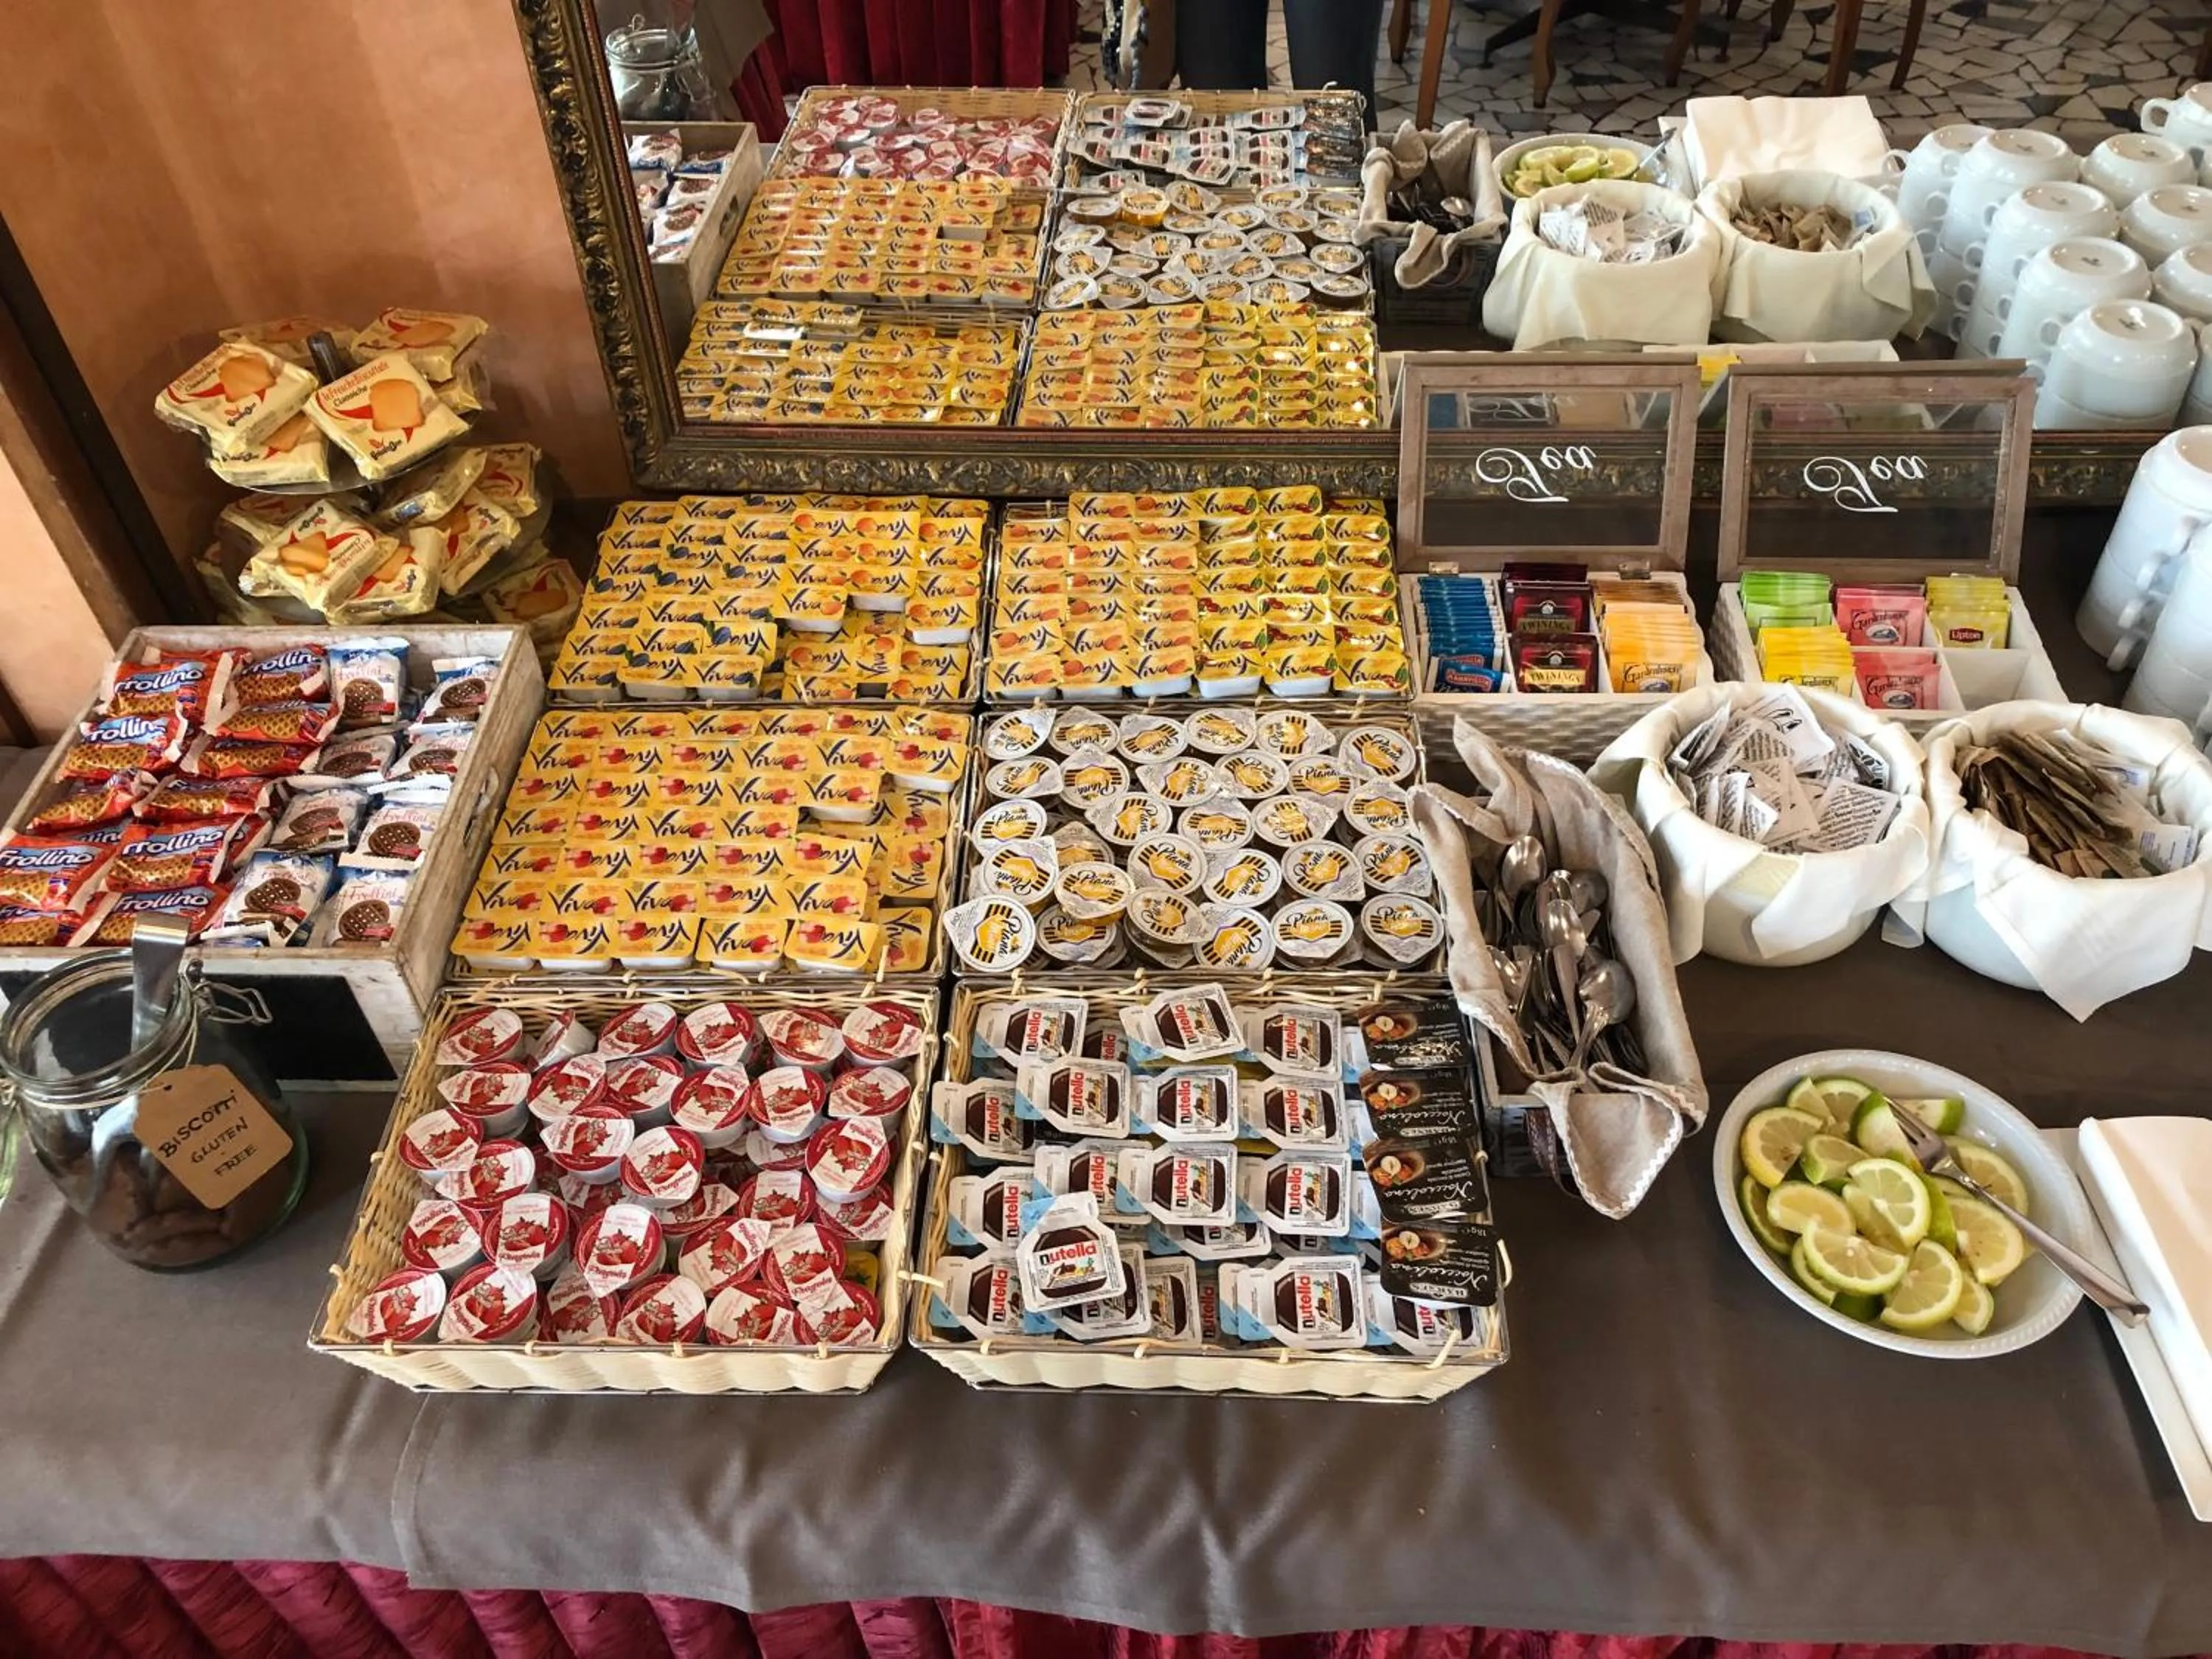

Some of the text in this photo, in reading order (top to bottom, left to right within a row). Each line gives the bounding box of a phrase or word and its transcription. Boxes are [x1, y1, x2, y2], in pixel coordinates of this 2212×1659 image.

[681, 501, 720, 516] Viva
[1155, 496, 1192, 516] Viva
[668, 524, 706, 543] Viva
[731, 520, 770, 540] Viva
[814, 518, 851, 537] Viva
[877, 518, 914, 540] Viva
[937, 524, 976, 545] Viva
[687, 549, 723, 569] Viva
[794, 539, 832, 558] Viva
[925, 546, 958, 566] Viva
[1006, 546, 1043, 568] Viva
[1090, 546, 1129, 567] Viva
[675, 572, 714, 594] Viva
[871, 572, 910, 593] Viva
[647, 600, 689, 622] Viva
[712, 595, 751, 618] Viva
[782, 588, 821, 612] Viva
[1002, 599, 1042, 623] Viva
[1088, 599, 1127, 620] Viva
[1218, 597, 1259, 619] Viva
[636, 627, 675, 651] Viva
[1203, 627, 1239, 652] Viva
[1520, 621, 1573, 632] TWININGS
[1951, 630, 1982, 643] Lipton
[730, 628, 770, 655] Viva
[1065, 628, 1105, 654] Viva
[557, 661, 597, 684] Viva
[648, 656, 687, 680] Viva
[694, 660, 734, 684] Viva
[812, 649, 850, 672] Viva
[922, 654, 961, 675] Viva
[993, 661, 1034, 686] Viva
[1082, 658, 1122, 683] Viva
[1126, 654, 1168, 678] Viva
[1272, 654, 1312, 678] Viva
[1530, 671, 1582, 684] TWININGS
[688, 715, 728, 736] Viva
[759, 714, 798, 736] Viva
[531, 743, 569, 770] Viva
[625, 746, 662, 773] Viva
[696, 746, 734, 772] Viva
[742, 742, 784, 770] Viva
[818, 739, 861, 768] Viva
[919, 748, 959, 773] Viva
[543, 774, 581, 802] Viva
[611, 779, 650, 807] Viva
[684, 779, 723, 805] Viva
[728, 776, 773, 805] Viva
[805, 774, 849, 802] Viva
[504, 809, 544, 838] Viva
[602, 815, 639, 841] Viva
[647, 810, 690, 838] Viva
[721, 811, 767, 839] Viva
[492, 846, 533, 873] Viva
[590, 849, 631, 878] Viva
[666, 846, 709, 874] Viva
[740, 848, 783, 874] Viva
[821, 846, 863, 874] Viva
[477, 881, 518, 911] Viva
[549, 883, 594, 915] Viva
[625, 881, 672, 913] Viva
[731, 883, 779, 914] Viva
[787, 883, 832, 913] Viva
[493, 922, 531, 952] Viva
[567, 923, 610, 955] Viva
[647, 919, 690, 952] Viva
[707, 922, 752, 955] Viva
[824, 922, 866, 957] Viva
[1026, 1011, 1043, 1052] nutella
[1174, 1004, 1198, 1044] nutella
[1102, 1034, 1116, 1060] tella
[1286, 1018, 1298, 1058] nutella
[1071, 1071, 1085, 1116] nutella
[1180, 1079, 1192, 1124] nutella
[987, 1096, 1001, 1144] nutella
[1287, 1089, 1300, 1133] nutella
[192, 1116, 248, 1164] GLUTEN
[214, 1144, 257, 1176] FREE
[1175, 1158, 1189, 1207] nutella
[1287, 1166, 1303, 1215] nutella
[1006, 1185, 1020, 1238] nutella
[1040, 1242, 1098, 1265] nutella
[992, 1269, 1009, 1322] nutella
[1301, 1275, 1312, 1328] nutella
